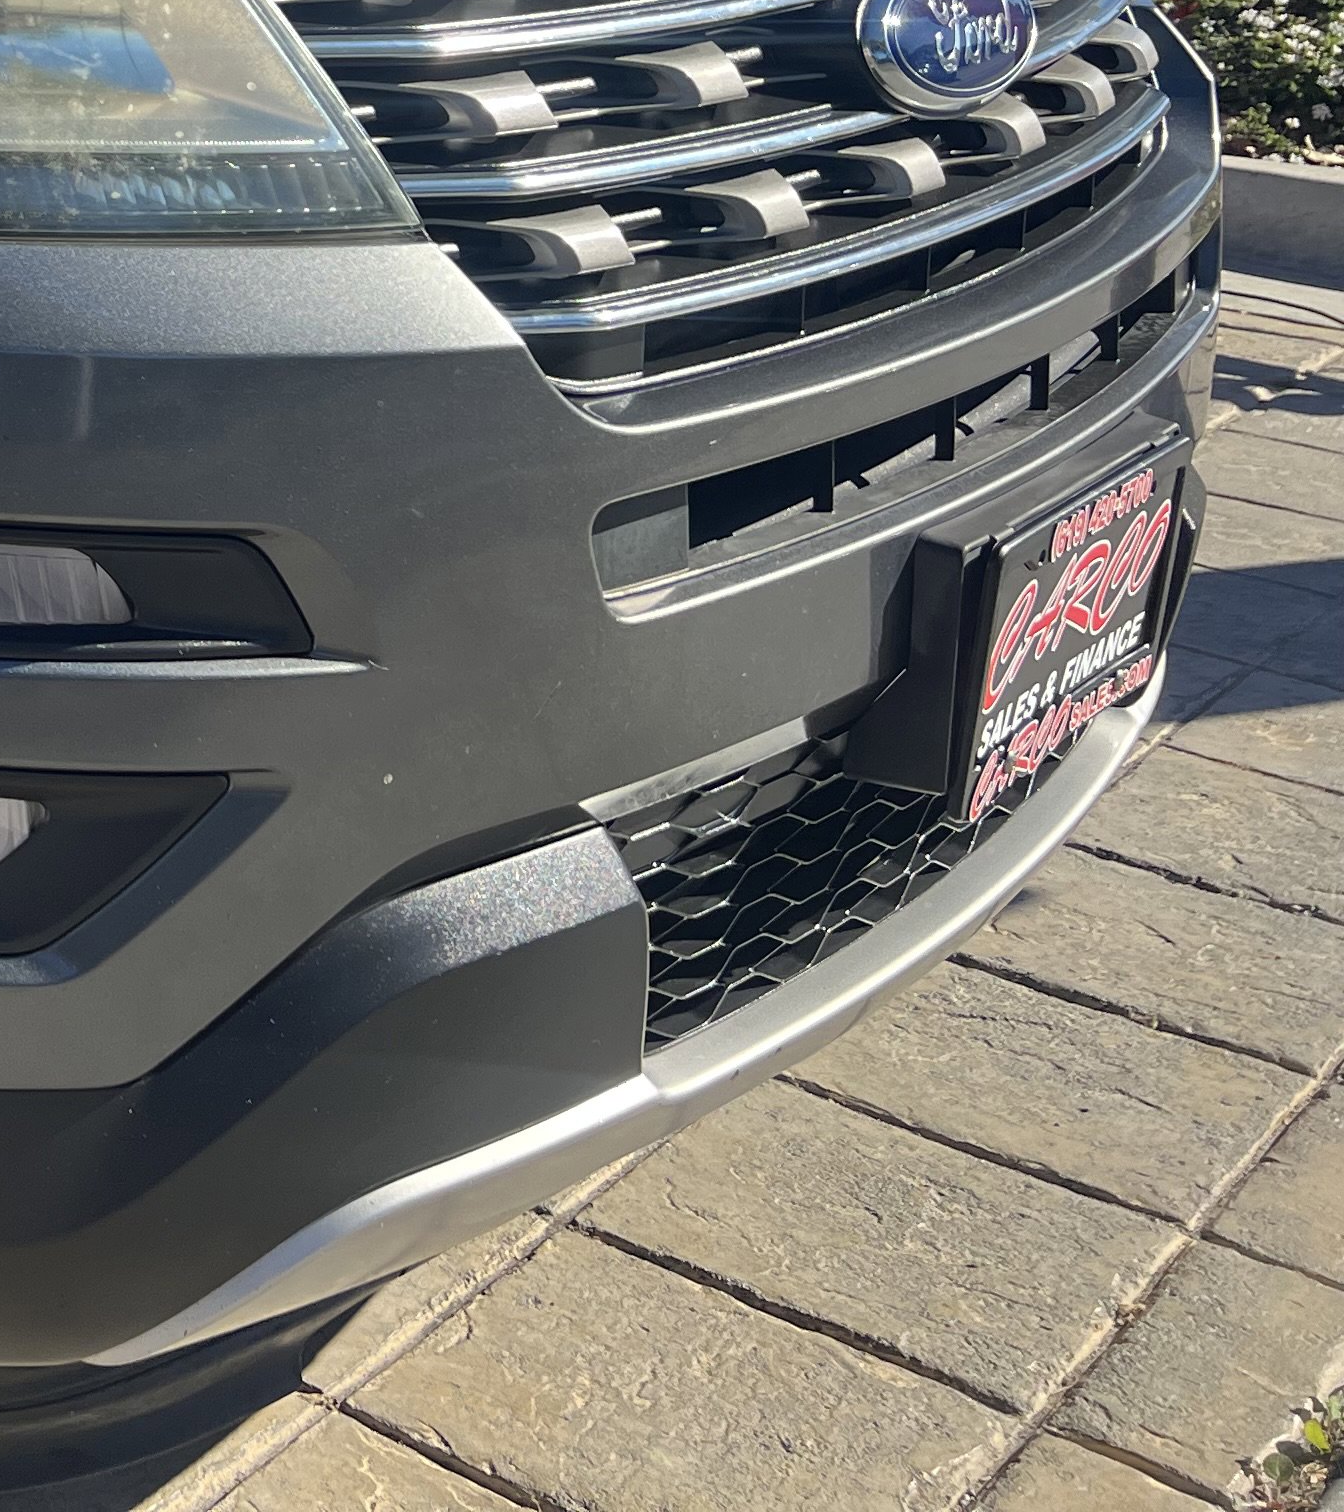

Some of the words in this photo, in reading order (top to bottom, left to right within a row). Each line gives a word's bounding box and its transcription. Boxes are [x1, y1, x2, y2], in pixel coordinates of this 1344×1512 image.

[977, 682, 1041, 760] SALES
[1040, 671, 1058, 708] &
[1059, 610, 1146, 696] FINANCE
[982, 498, 1172, 714] CARCO
